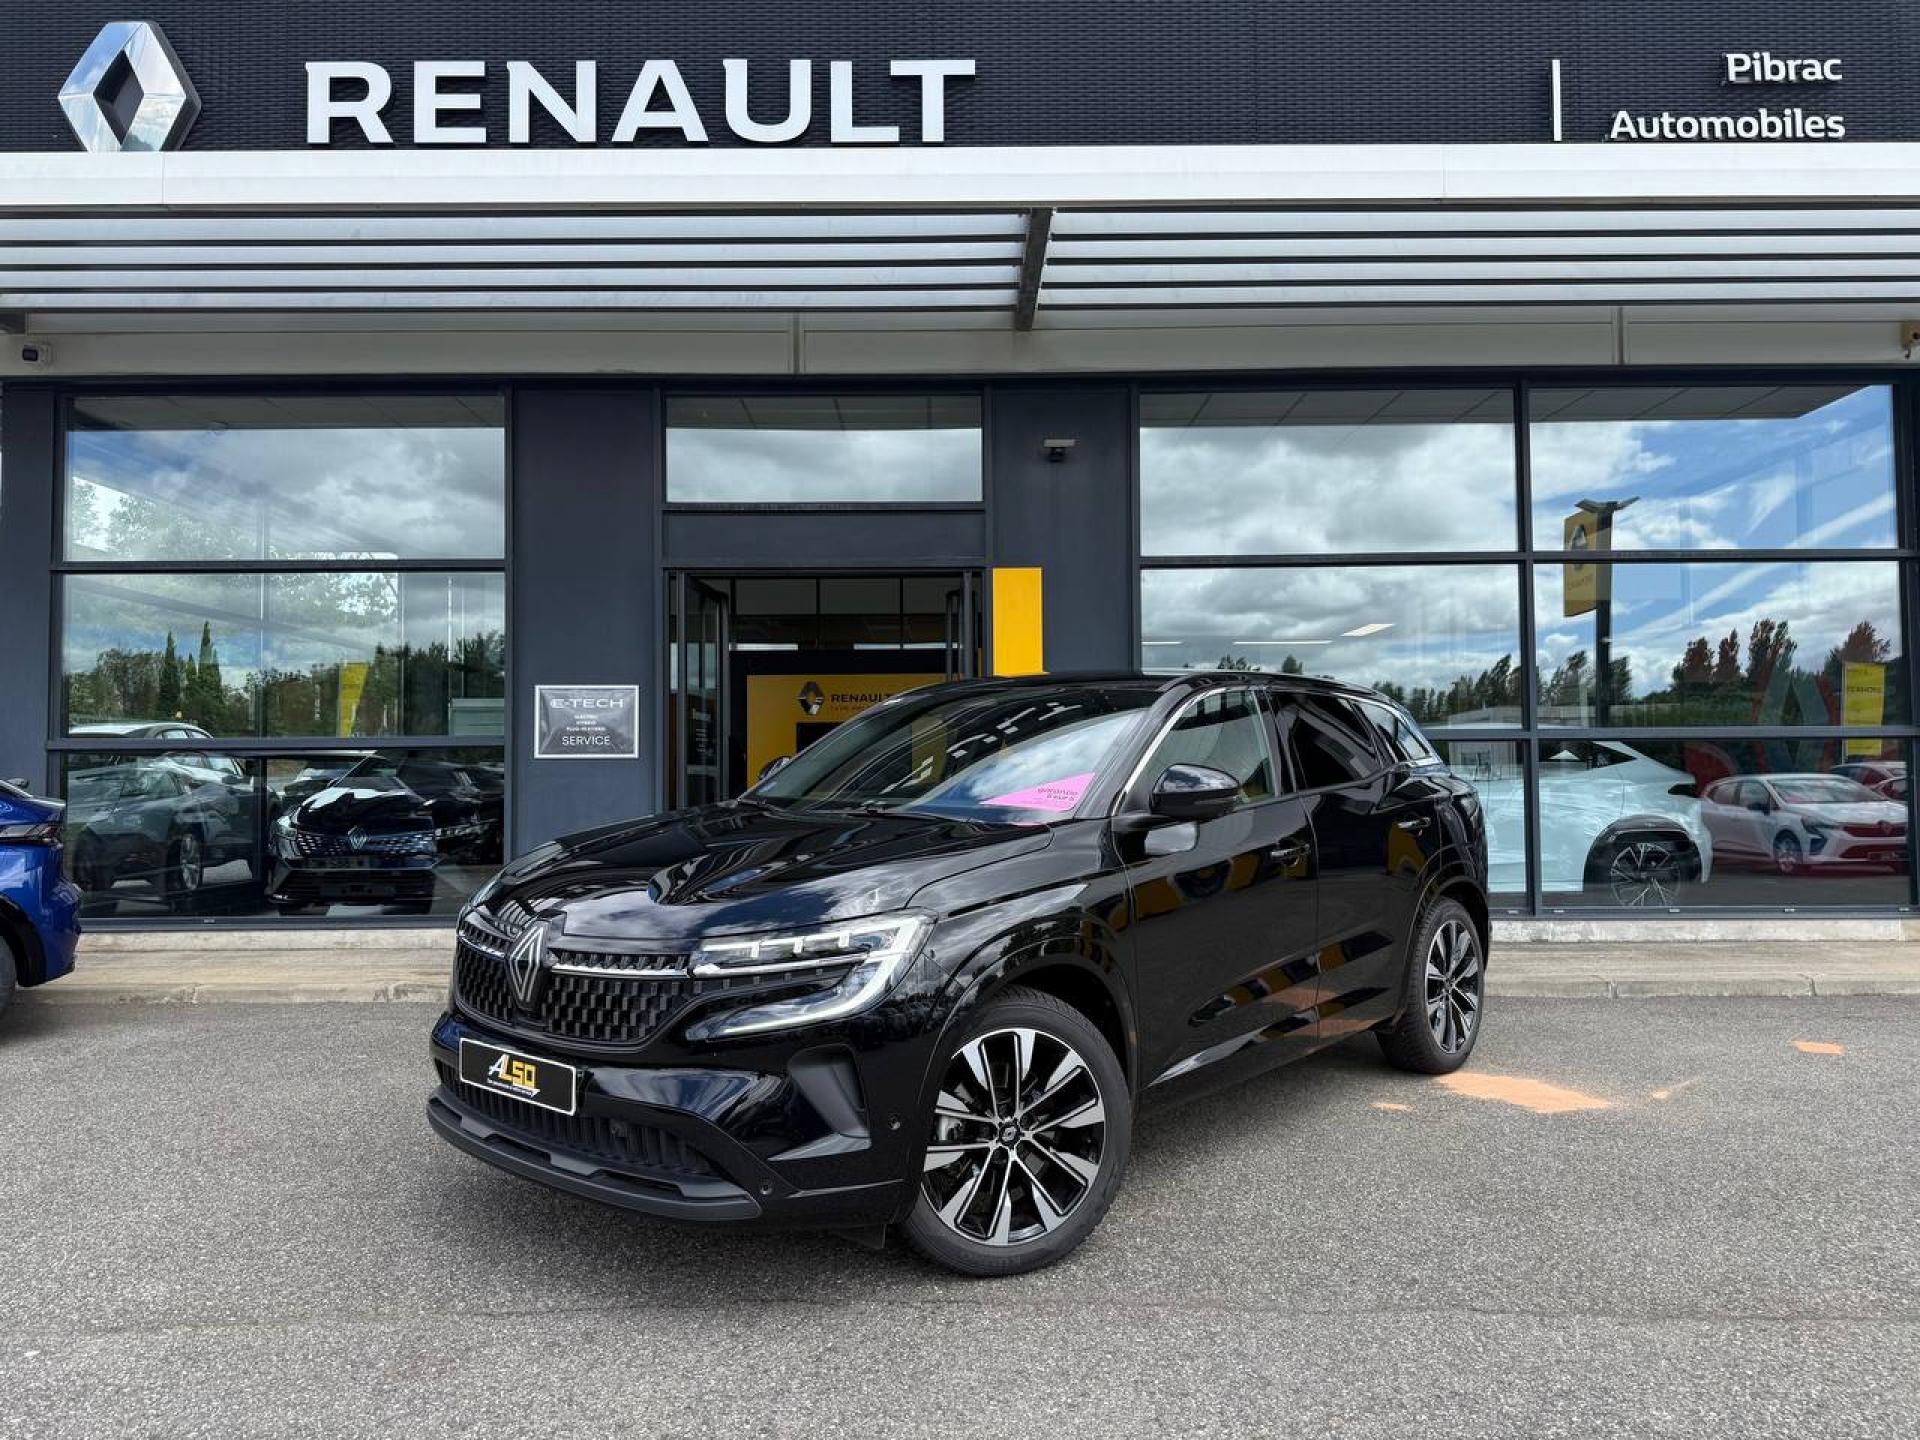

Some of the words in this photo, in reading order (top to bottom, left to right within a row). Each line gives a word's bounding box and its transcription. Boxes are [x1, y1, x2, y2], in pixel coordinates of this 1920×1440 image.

[1725, 52, 1843, 82] Pibrac
[305, 59, 976, 144] RENAULT
[1609, 108, 1846, 140] Automobiles
[551, 698, 624, 708] E-TECH
[562, 735, 611, 746] SERVICE
